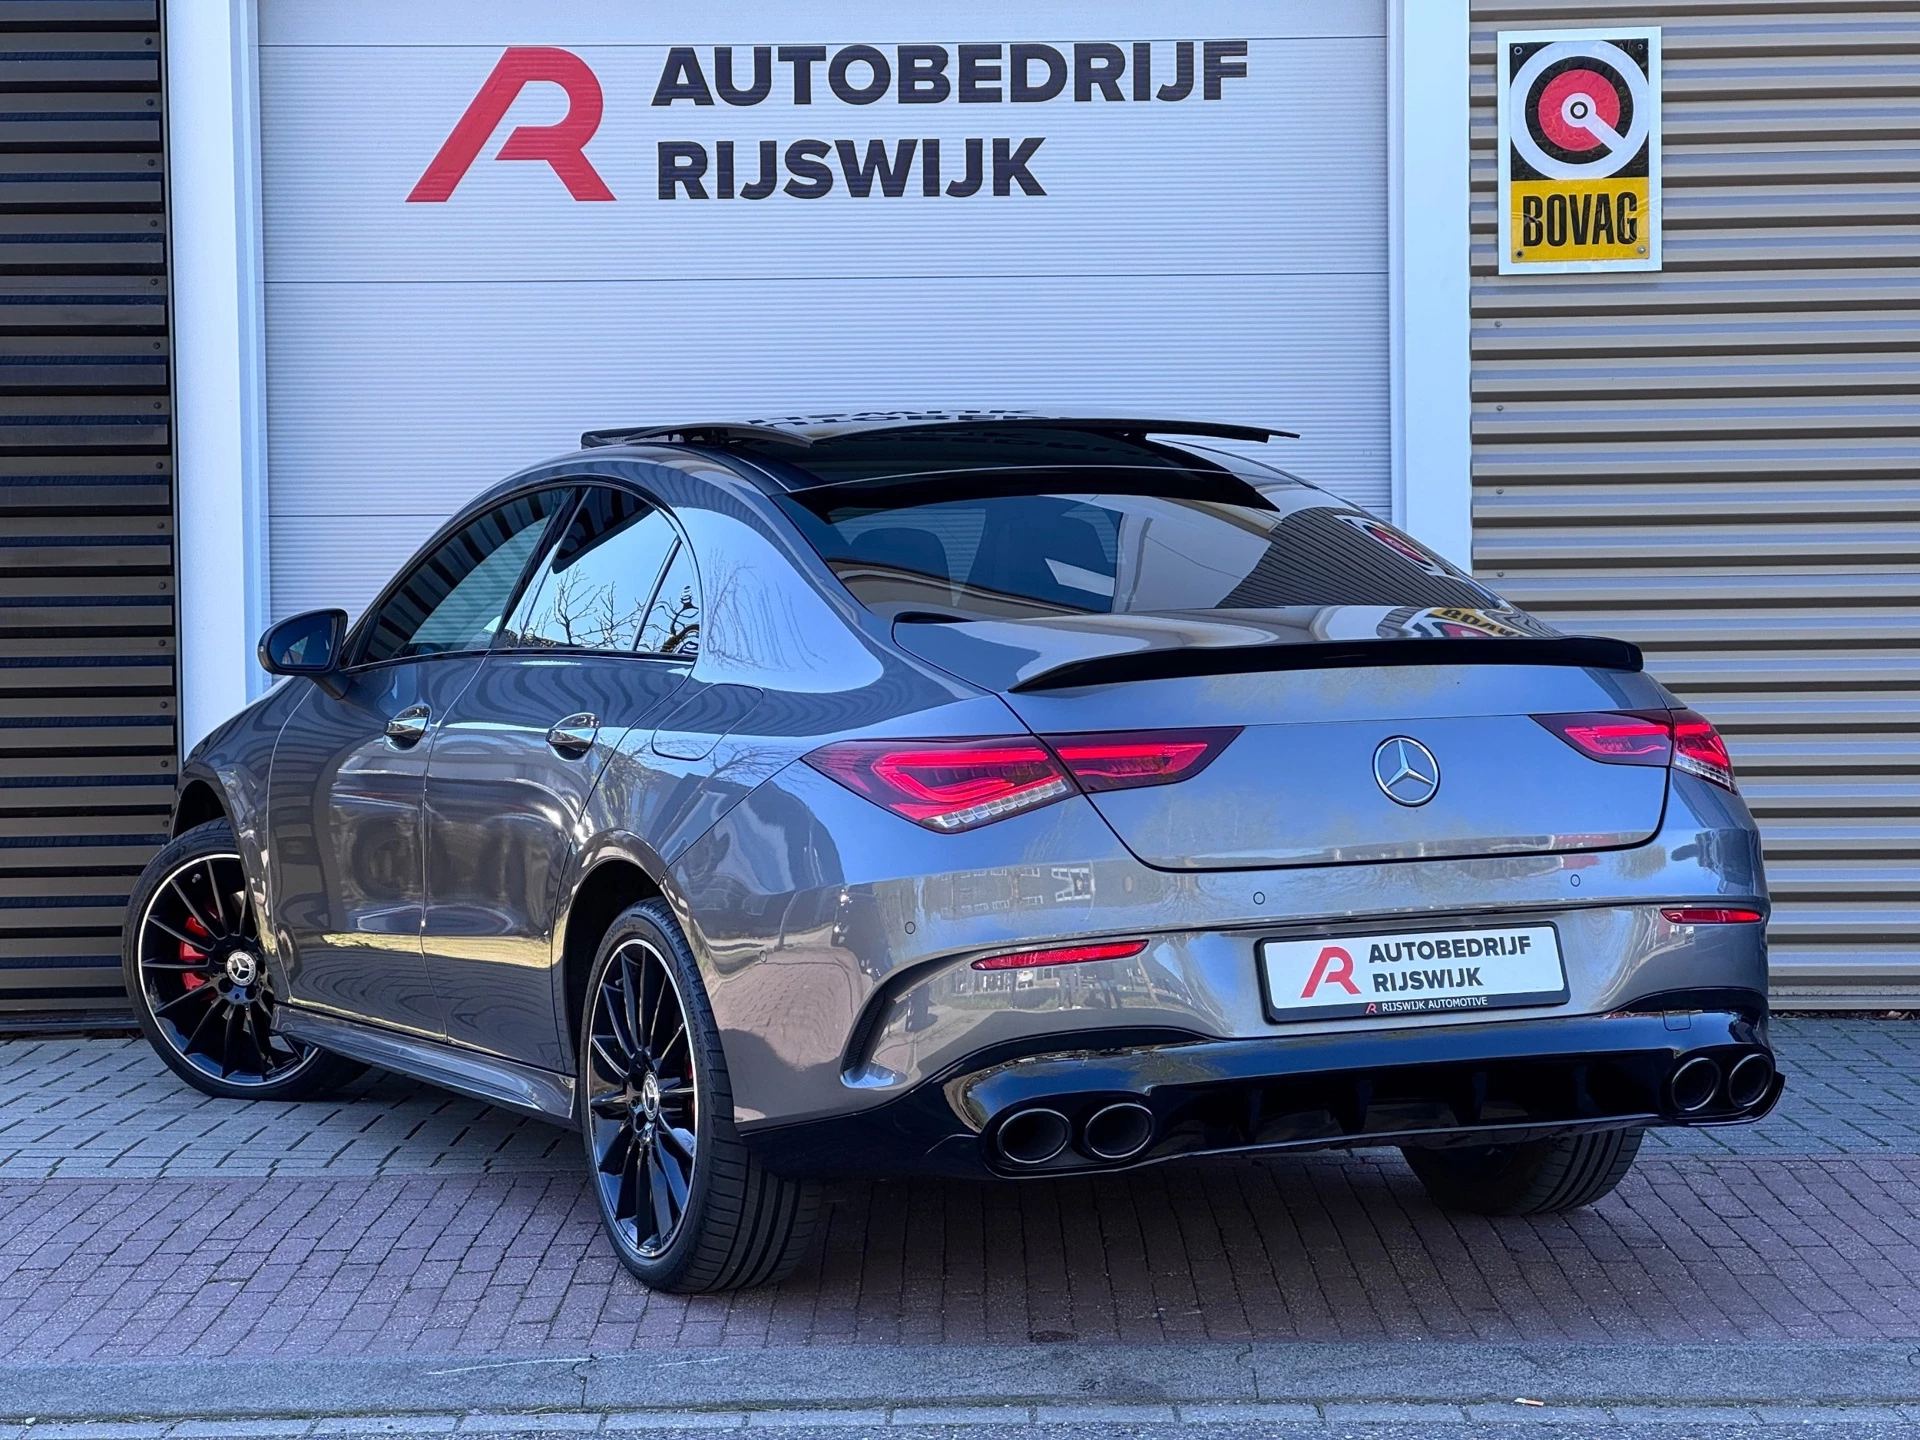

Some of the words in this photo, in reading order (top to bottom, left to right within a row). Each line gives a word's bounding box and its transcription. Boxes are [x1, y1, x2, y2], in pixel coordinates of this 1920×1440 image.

[652, 41, 1247, 106] AUTOBEDRIJF
[657, 137, 1048, 201] RIJSWIJK
[1522, 191, 1638, 247] BOVAG
[1368, 935, 1531, 963] AUTOBEDRIJF
[1372, 967, 1484, 993] RIJSWIJK
[1382, 1000, 1426, 1013] RIJSWIJK
[1428, 996, 1489, 1009] AUTOMOTIVE
